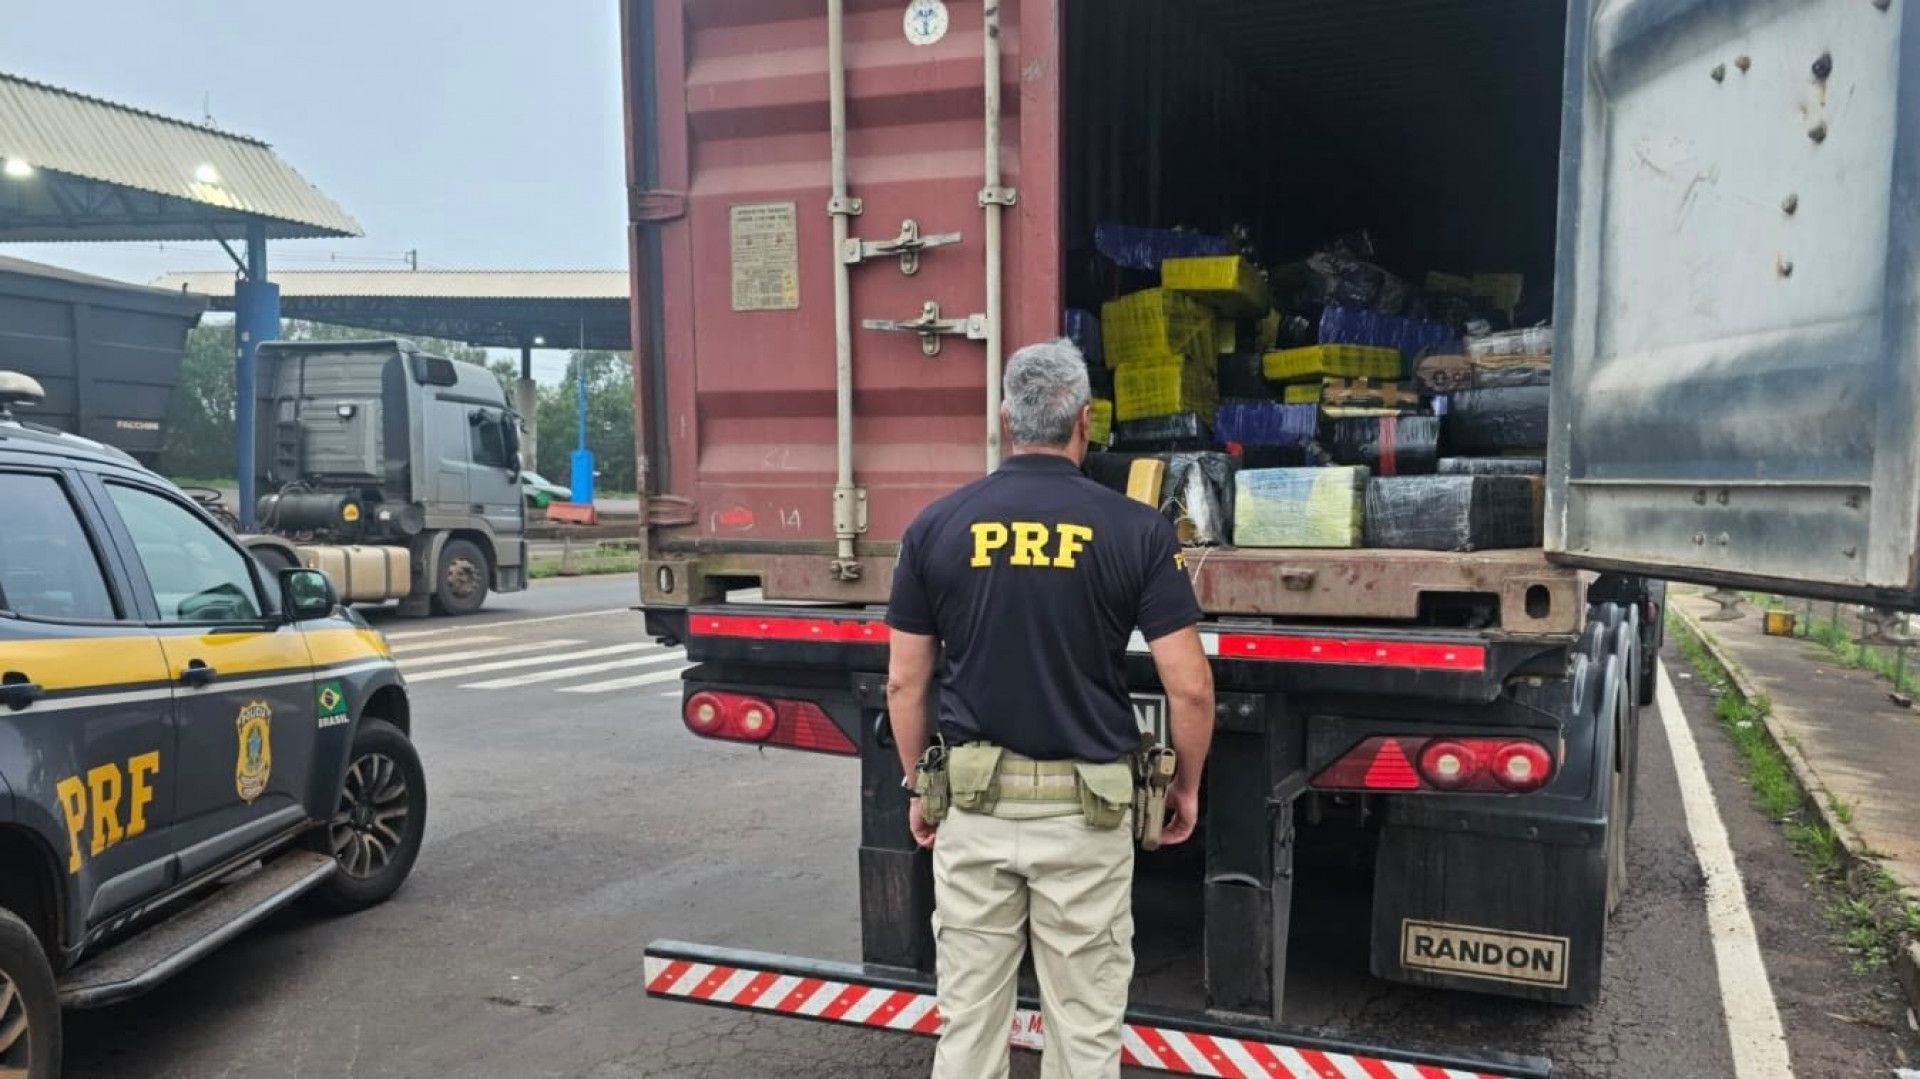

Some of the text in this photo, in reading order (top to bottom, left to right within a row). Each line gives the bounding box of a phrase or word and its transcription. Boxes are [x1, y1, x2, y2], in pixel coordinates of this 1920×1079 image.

[970, 521, 1093, 569] PRF
[1173, 553, 1188, 570] P
[318, 713, 351, 728] BRASIL
[56, 750, 161, 874] PRF
[1413, 934, 1555, 973] RANDON
